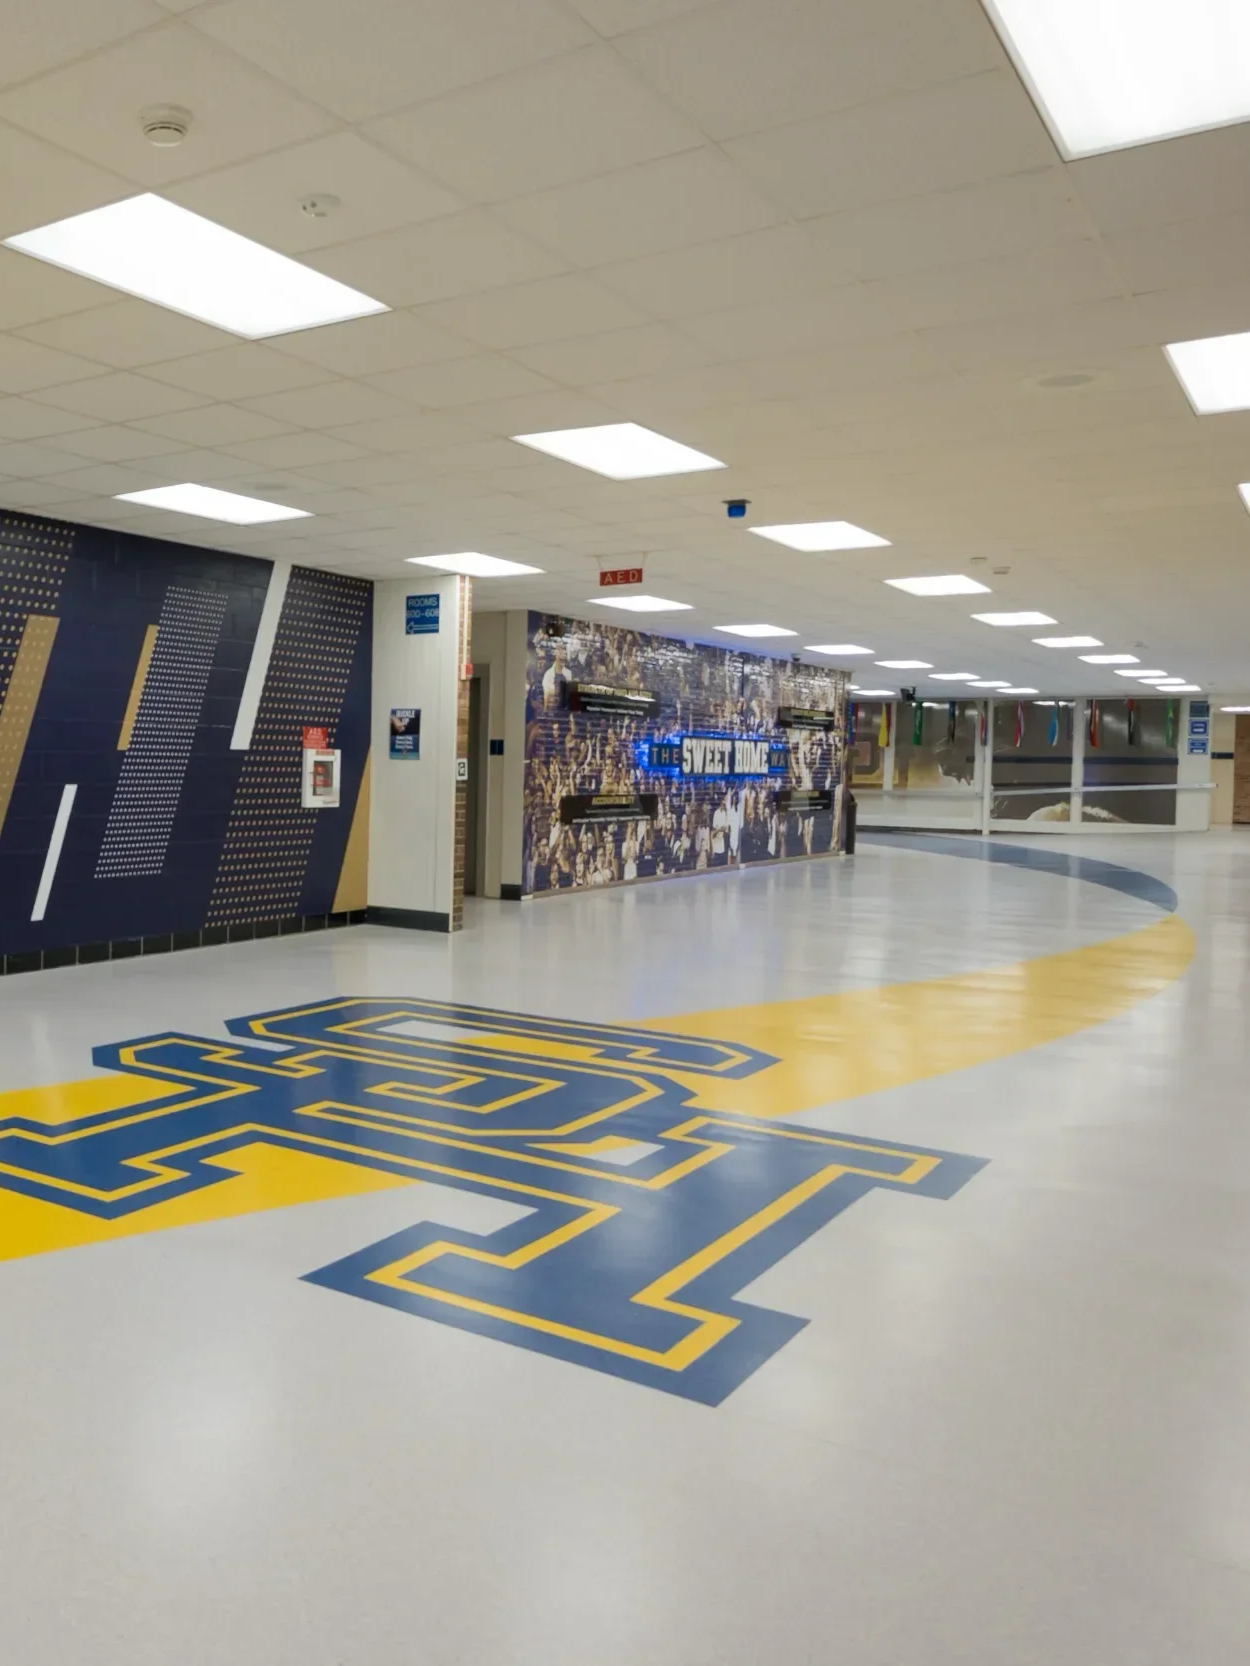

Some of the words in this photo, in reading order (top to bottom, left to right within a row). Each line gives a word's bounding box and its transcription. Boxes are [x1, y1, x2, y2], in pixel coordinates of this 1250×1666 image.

[408, 597, 438, 607] ROOMS
[652, 747, 679, 764] THE
[682, 738, 732, 774] SWEET
[734, 741, 770, 774] HOME
